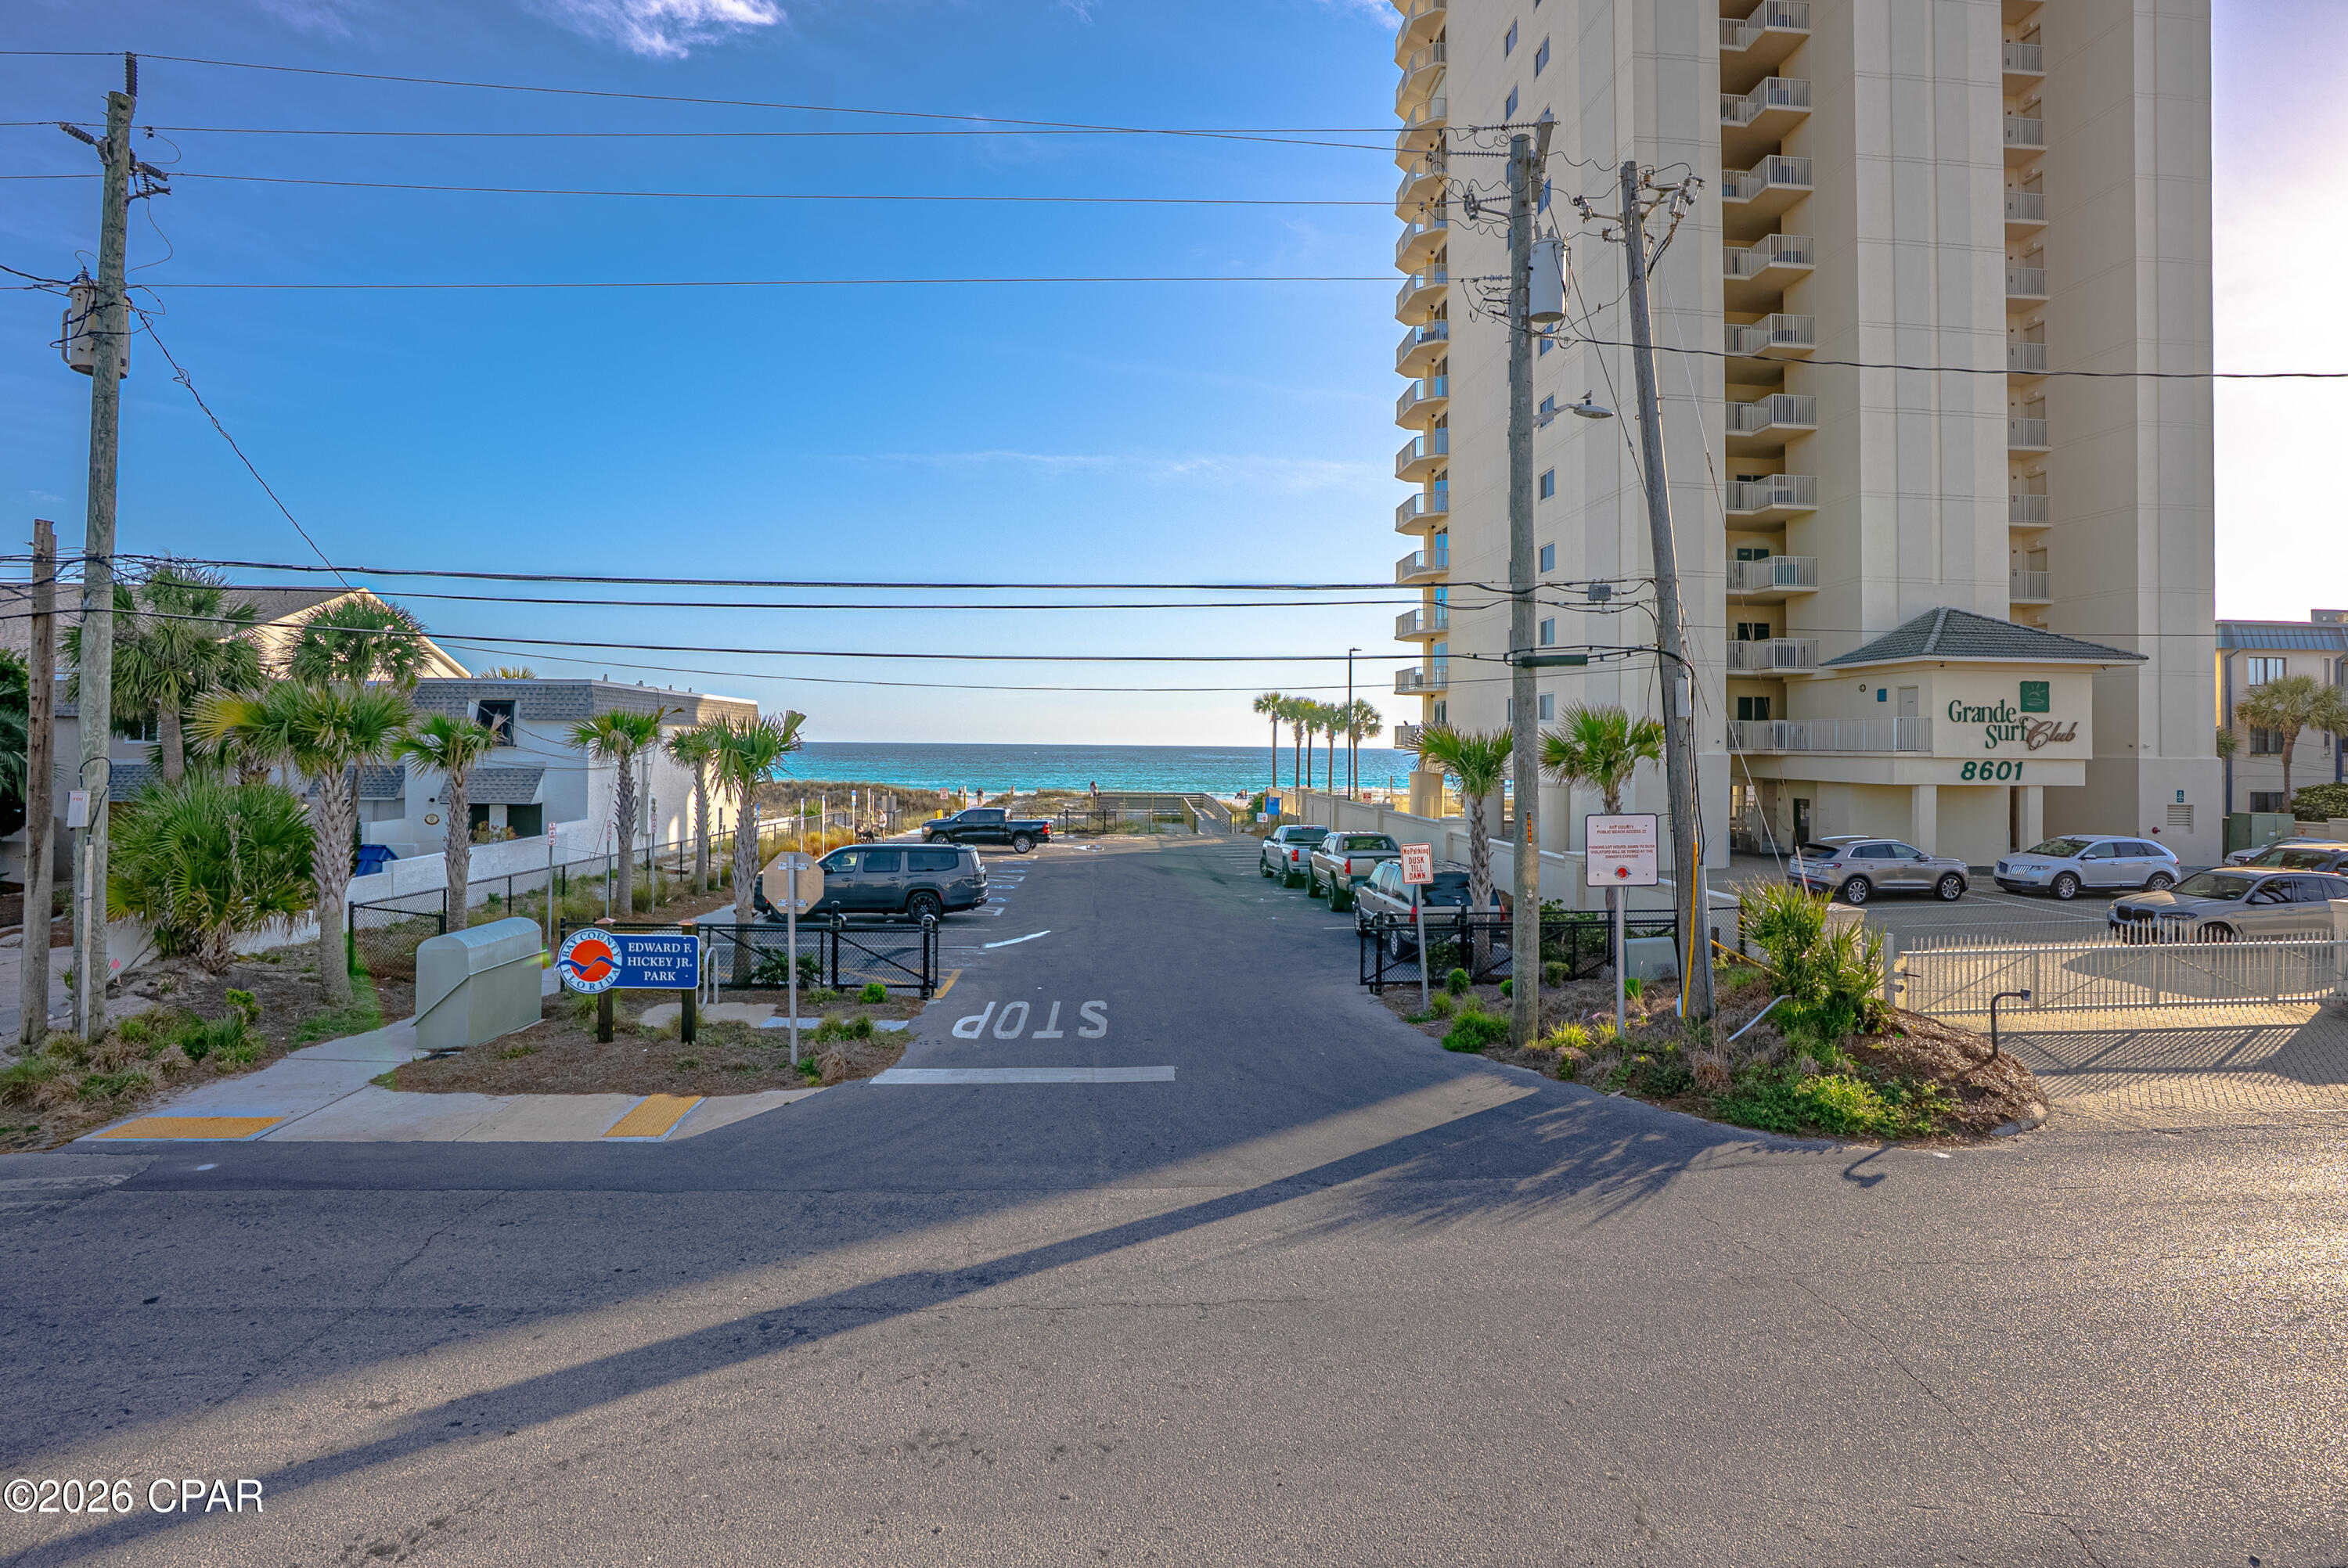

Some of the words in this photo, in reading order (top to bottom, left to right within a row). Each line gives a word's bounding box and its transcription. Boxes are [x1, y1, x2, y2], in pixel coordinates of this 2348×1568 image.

[1948, 699, 2017, 723] Grande
[2018, 715, 2079, 751] Club
[1961, 761, 2023, 781] 8601
[562, 937, 578, 957] BAY
[580, 931, 621, 958] COUNTY
[628, 943, 680, 953] EDWARD
[683, 944, 692, 953] F.
[627, 956, 672, 967] HICKEY
[675, 957, 693, 969] JR.
[563, 969, 620, 991] FLORIDA
[643, 971, 676, 981] PARK
[952, 1001, 1107, 1039] STOP
